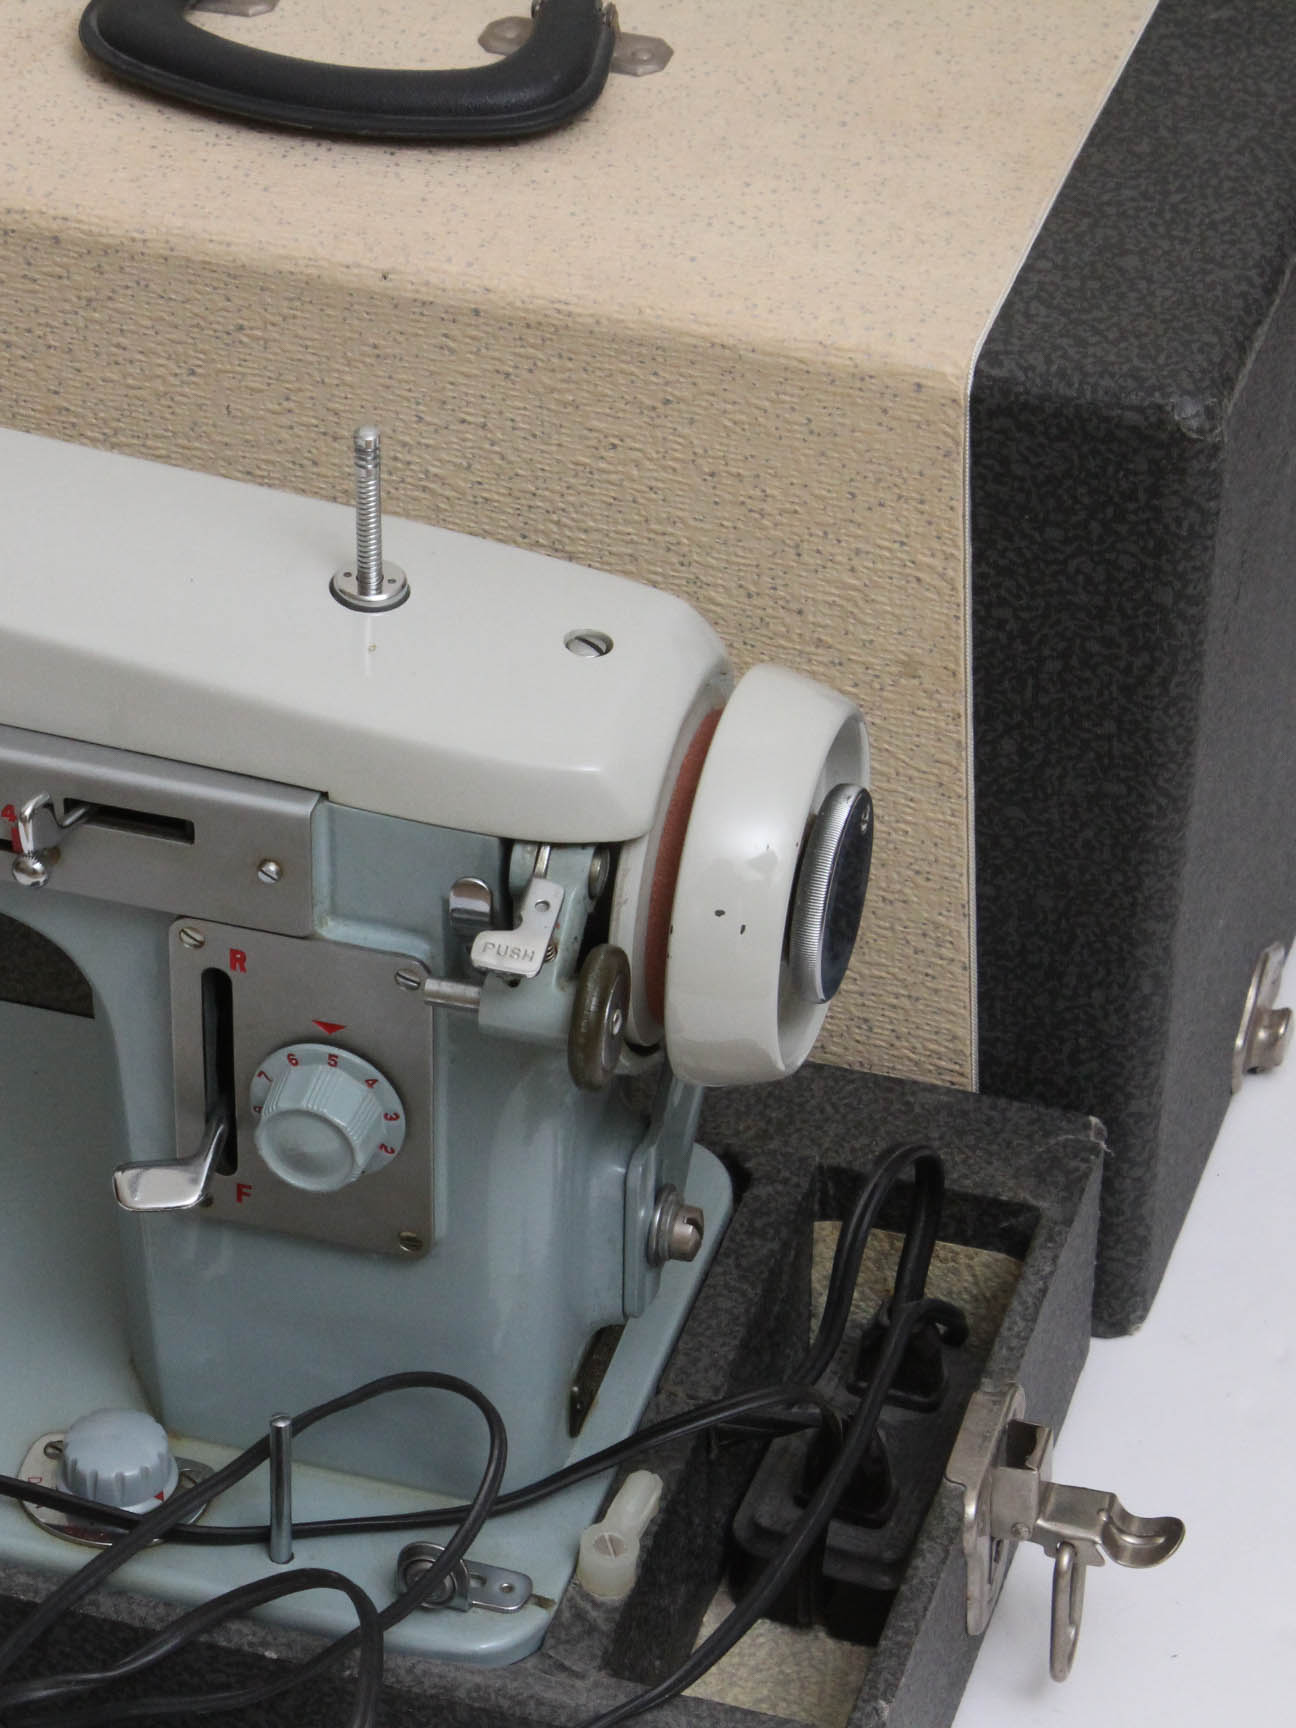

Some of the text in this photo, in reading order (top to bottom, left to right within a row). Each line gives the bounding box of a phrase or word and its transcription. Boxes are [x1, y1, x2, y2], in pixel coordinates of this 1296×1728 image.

[1, 804, 17, 822] 4
[229, 948, 247, 973] R
[482, 941, 535, 963] PUSH
[287, 1053, 299, 1067] 6
[327, 1053, 339, 1068] 5
[235, 1183, 252, 1203] F
